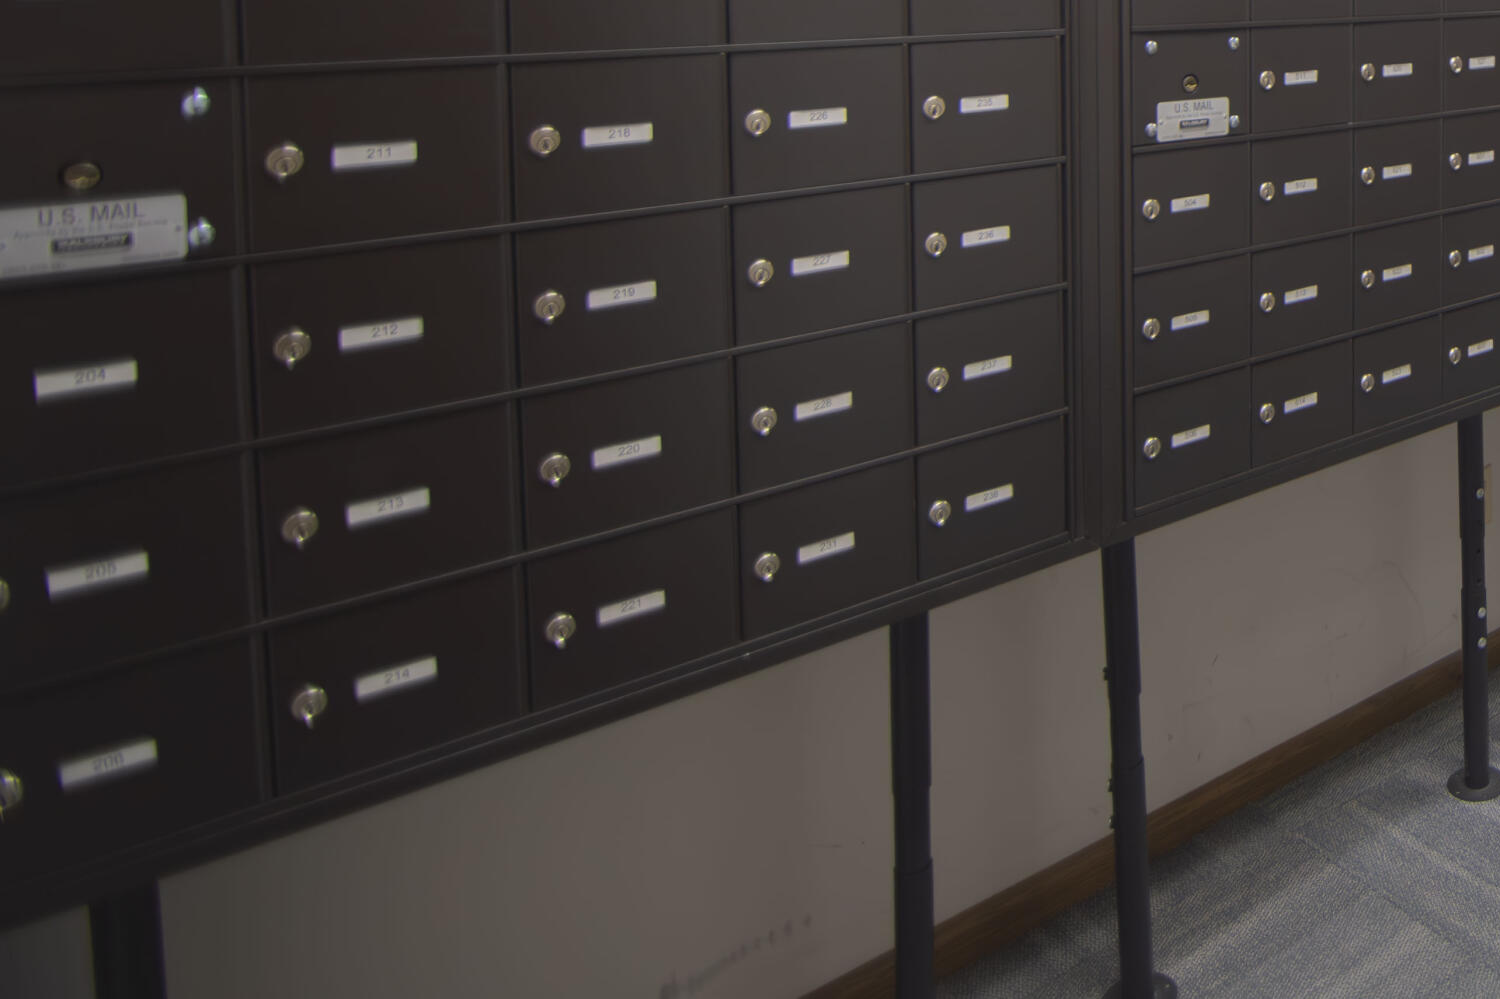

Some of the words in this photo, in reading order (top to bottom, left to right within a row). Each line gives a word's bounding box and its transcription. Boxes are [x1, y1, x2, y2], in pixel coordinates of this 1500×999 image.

[977, 96, 993, 107] 235
[1174, 103, 1191, 114] U.S.
[1193, 101, 1214, 112] MAIL
[810, 111, 828, 121] 226
[608, 127, 630, 139] 218
[366, 146, 392, 159] 211
[38, 206, 82, 227] U.S.
[90, 202, 145, 222] MAIL
[978, 230, 994, 240] 236
[813, 254, 831, 266] 227
[613, 286, 635, 300] 219
[372, 322, 398, 338] 212
[981, 359, 996, 371] 237
[75, 366, 106, 384] 204
[814, 397, 832, 411] 228
[618, 442, 640, 457] 220
[378, 495, 403, 512] 213
[620, 597, 641, 613] 221
[384, 666, 410, 685] 214
